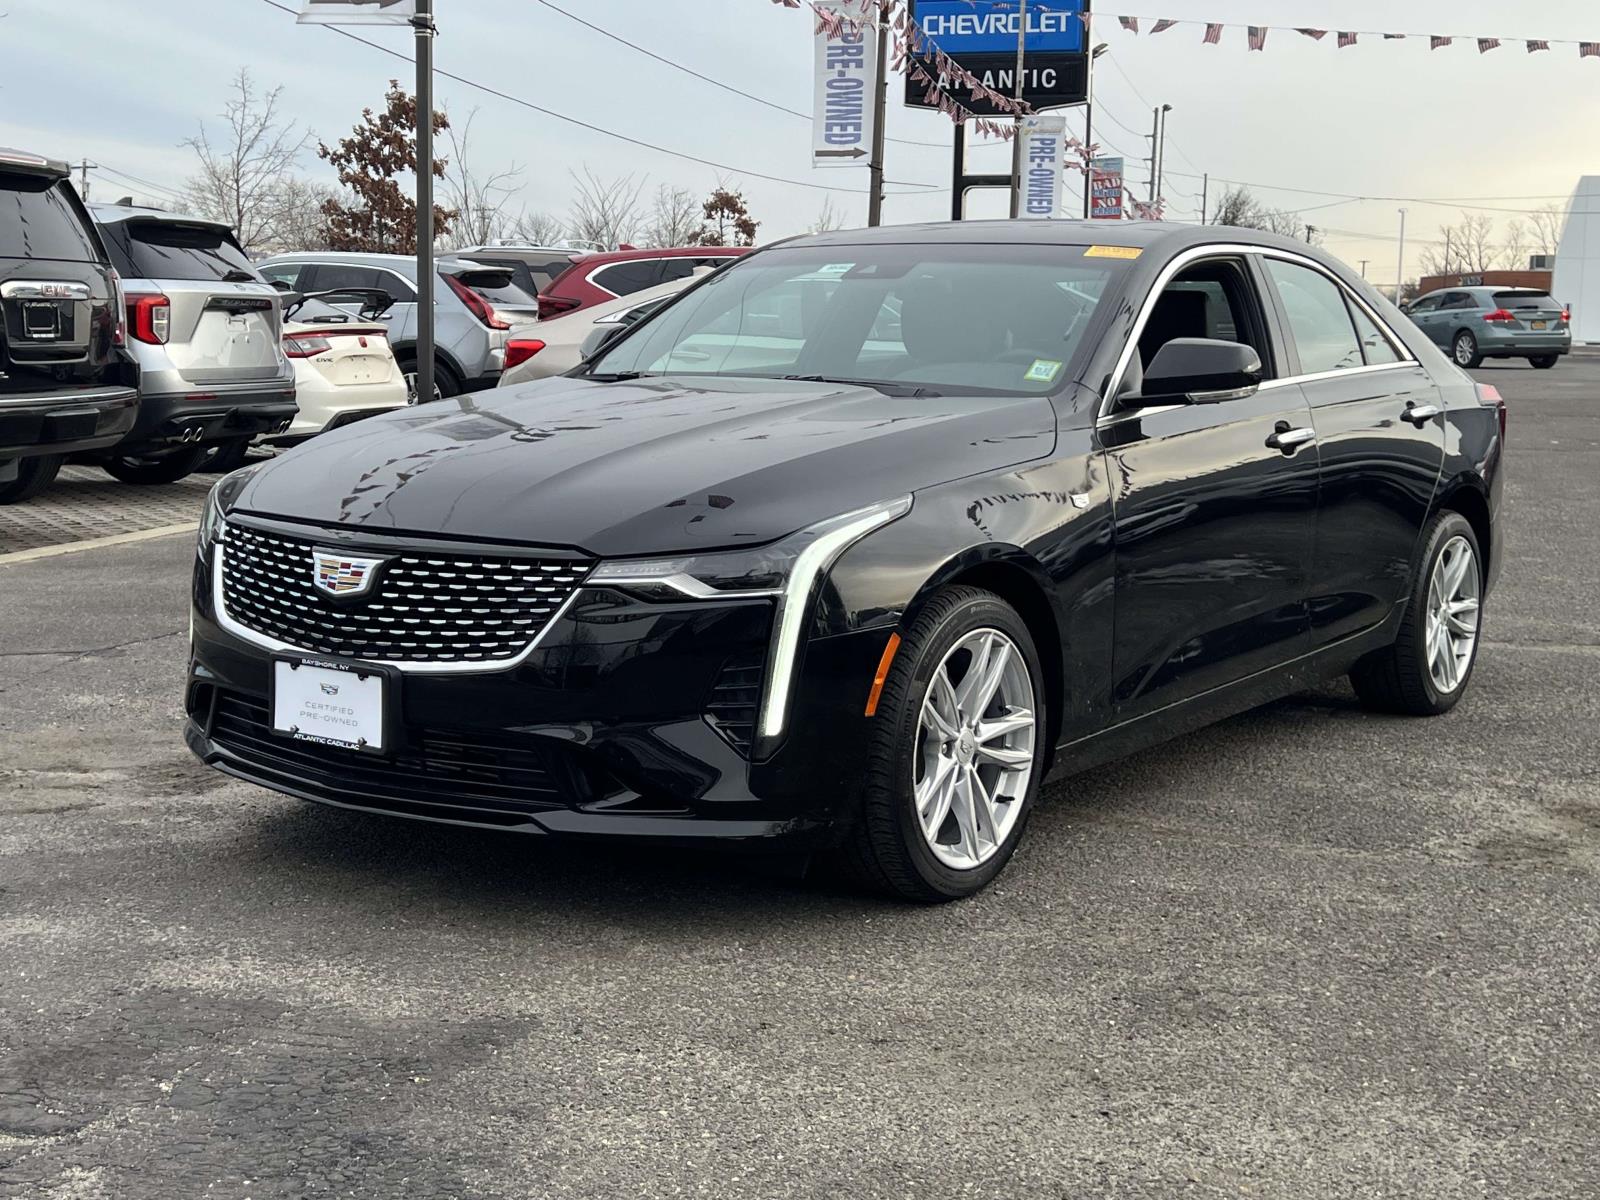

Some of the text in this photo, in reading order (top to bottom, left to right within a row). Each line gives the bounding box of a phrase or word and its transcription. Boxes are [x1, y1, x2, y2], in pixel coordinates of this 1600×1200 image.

[923, 12, 1071, 35] CHEVROLET
[825, 31, 863, 144] PRE-OWNED
[1027, 138, 1056, 214] PRE-OWNED
[299, 710, 358, 727] PRE-OWNED
[305, 701, 354, 716] CERTIFIED
[293, 733, 360, 751] ATLANTIC CADILLAC
